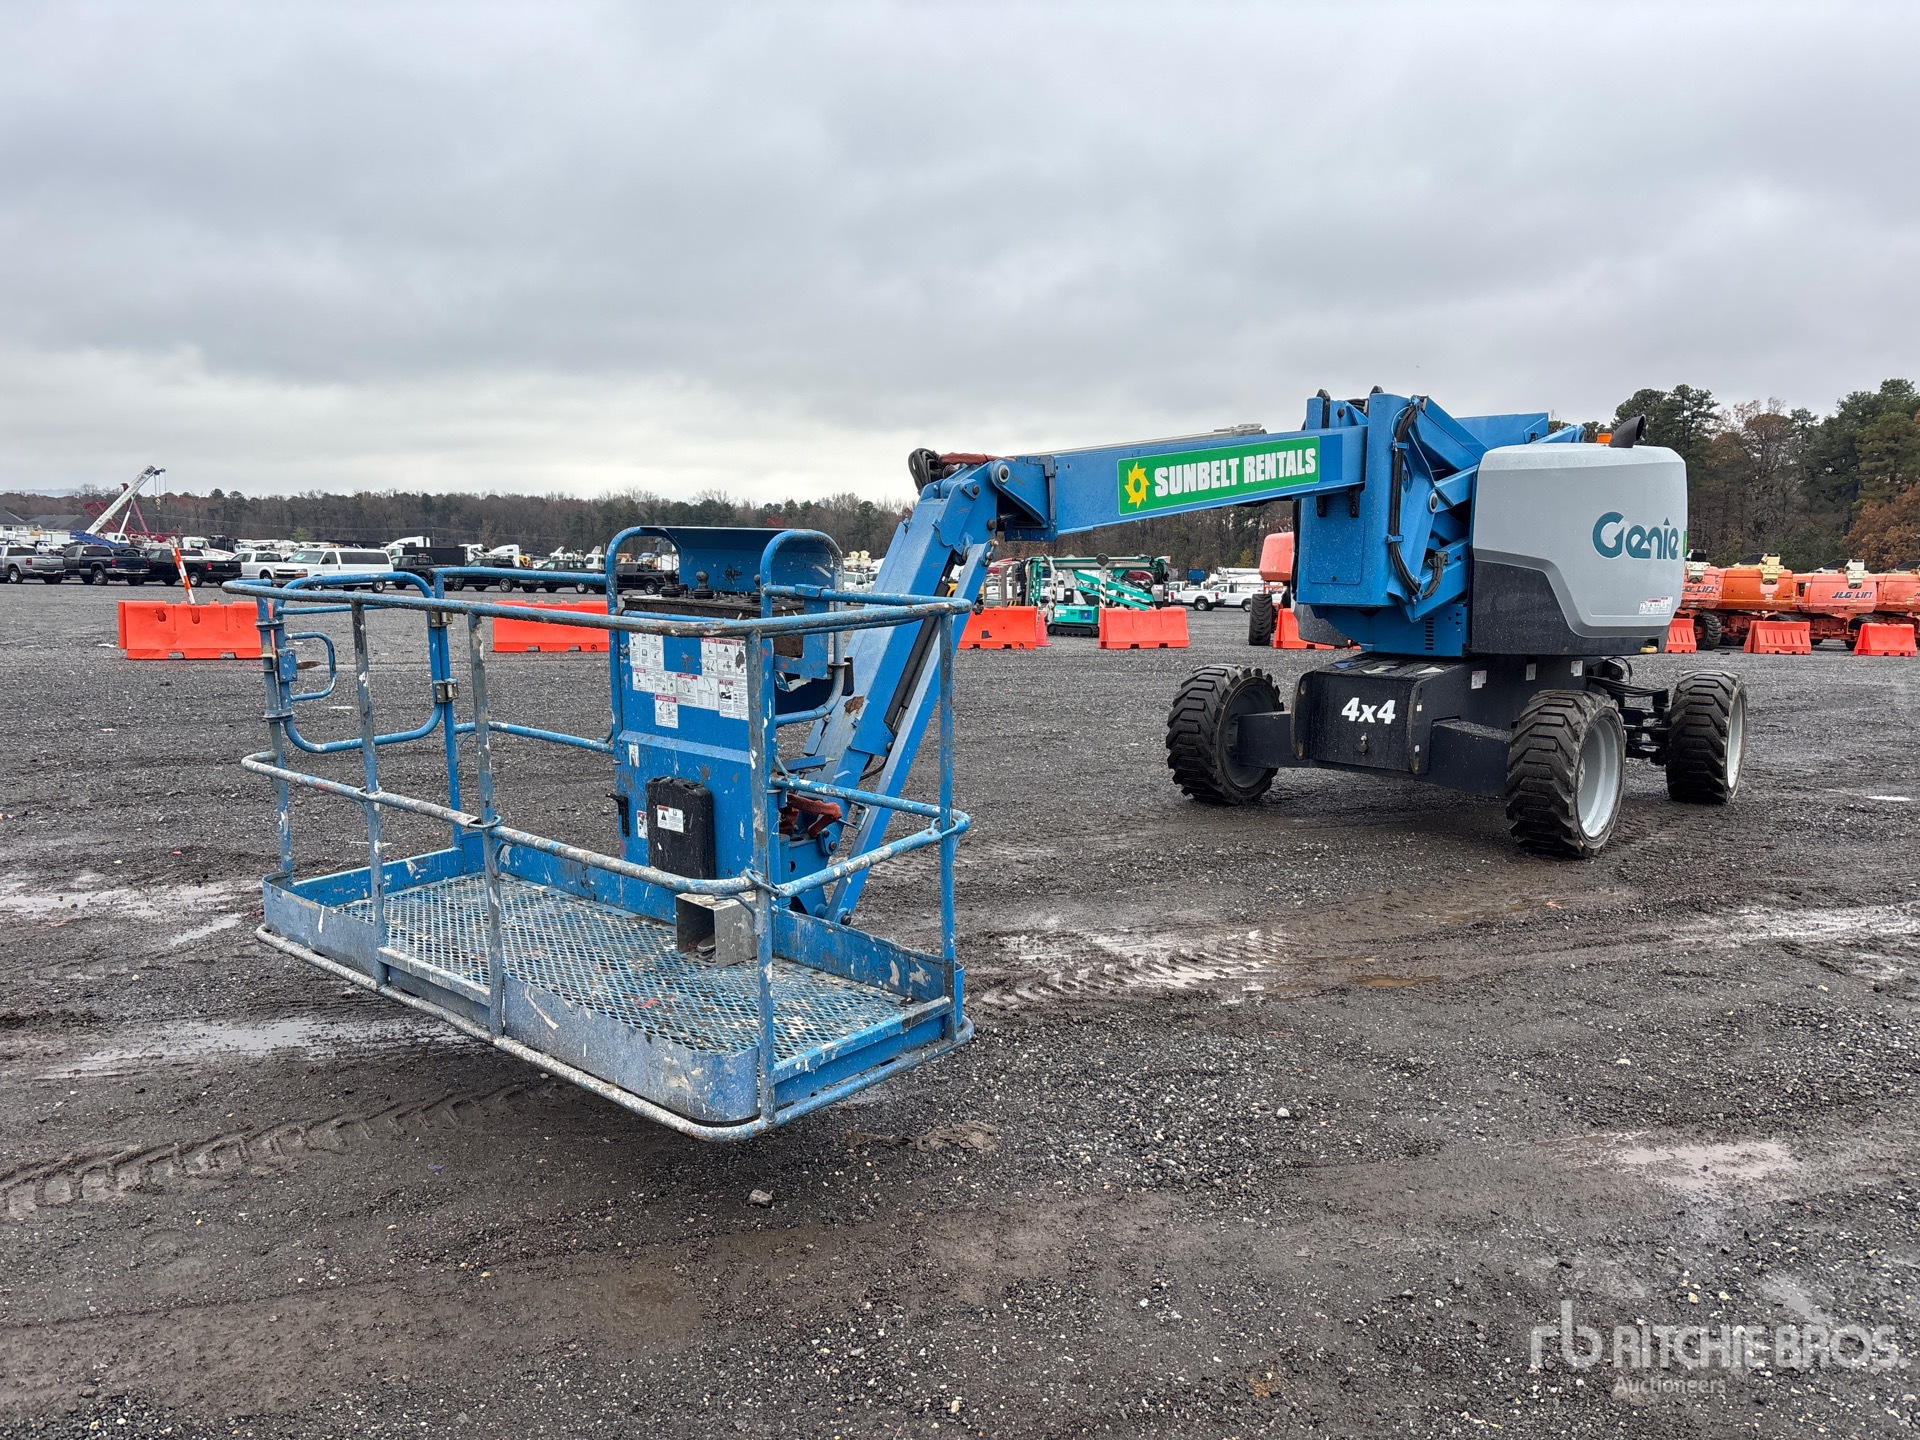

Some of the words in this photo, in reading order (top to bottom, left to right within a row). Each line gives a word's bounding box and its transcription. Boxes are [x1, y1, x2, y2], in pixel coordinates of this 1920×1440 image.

[1154, 457, 1240, 497] SUNBELT
[1243, 447, 1317, 484] RENTALS
[1592, 511, 1679, 560] Genie
[1831, 591, 1853, 599] JLG
[1855, 591, 1873, 599] LIFT
[1341, 697, 1396, 725] 4x4
